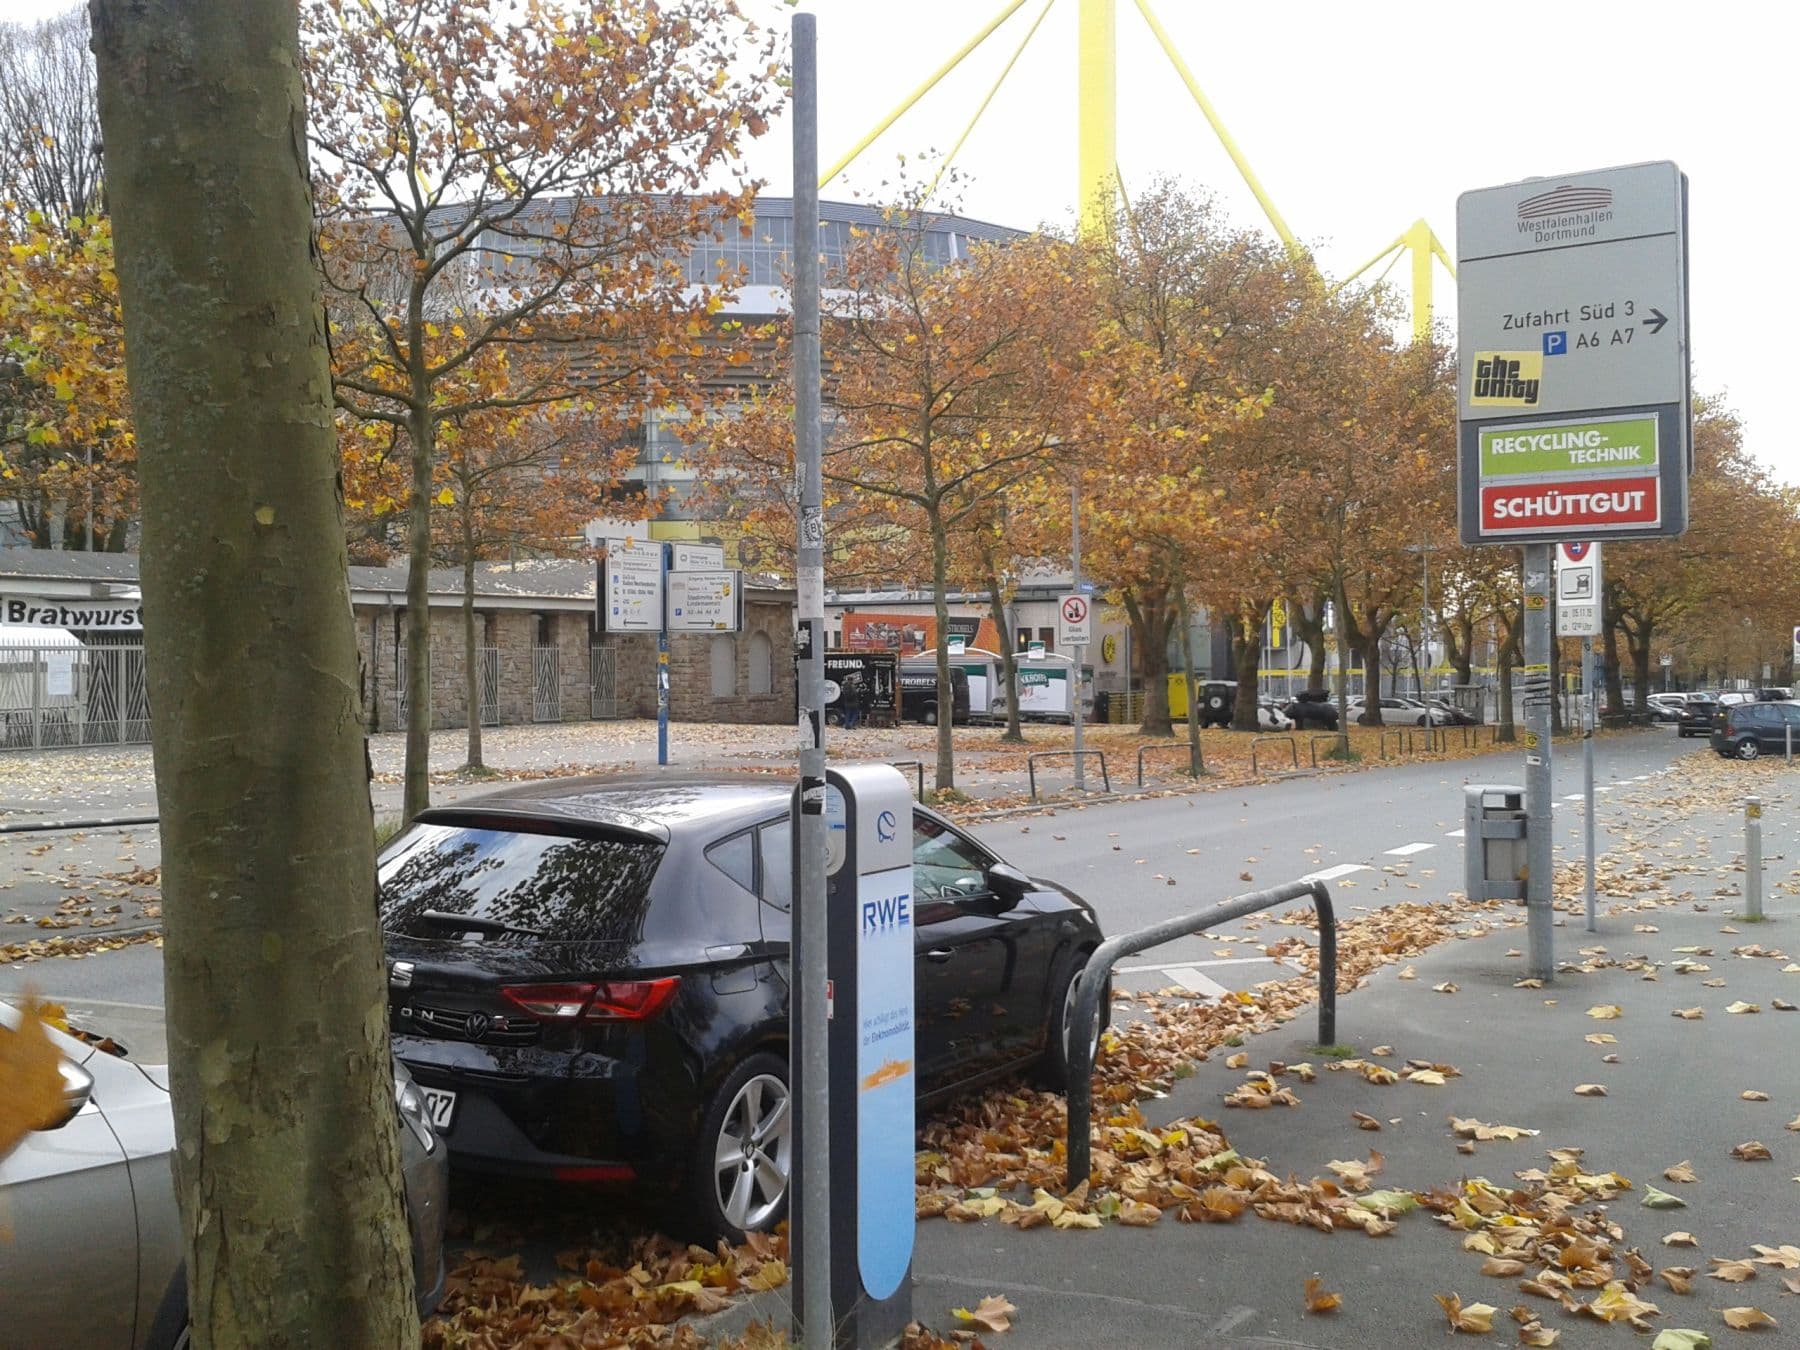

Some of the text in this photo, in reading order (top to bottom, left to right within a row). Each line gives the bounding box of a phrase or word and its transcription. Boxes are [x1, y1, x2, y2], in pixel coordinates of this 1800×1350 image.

[1517, 210, 1613, 234] Westfalenhallen
[1535, 224, 1595, 243] Dortmund
[1502, 300, 1635, 330] Zufahrt Süd 3
[1575, 333, 1600, 349] A6
[1610, 327, 1635, 346] A7
[1476, 355, 1521, 379] the
[1474, 378, 1540, 404] unity
[1491, 429, 1609, 456] RECYCLING-
[1568, 445, 1641, 465] TECHNIK
[1493, 490, 1646, 519] SCHÜTTGUT
[899, 678, 937, 686] TROBELS
[863, 894, 910, 930] RWE
